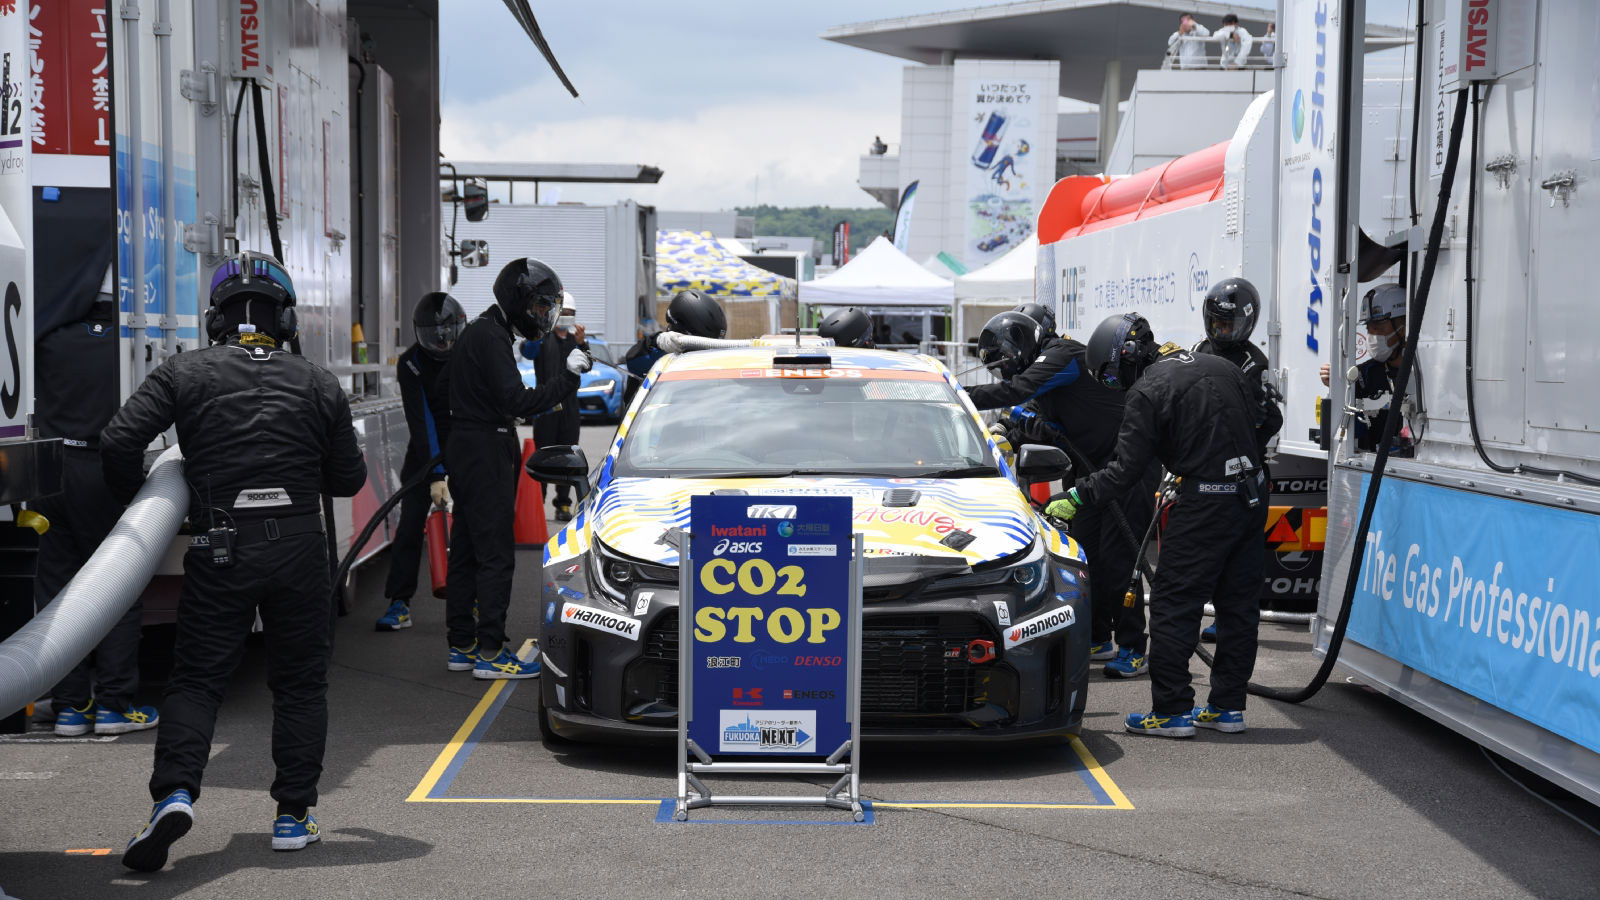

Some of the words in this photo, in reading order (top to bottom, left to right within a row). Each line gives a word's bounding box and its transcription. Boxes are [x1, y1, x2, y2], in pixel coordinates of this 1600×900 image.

[1306, 167, 1323, 355] Hydro
[765, 369, 862, 377] ENEOS
[1200, 483, 1237, 492] sparco
[247, 492, 280, 501] sparco
[711, 525, 767, 537] Iwatani
[729, 542, 763, 553] asics
[700, 558, 807, 597] CO2
[1364, 531, 1396, 601] The
[1402, 543, 1442, 618] Gas
[694, 607, 841, 643] STOP
[707, 656, 741, 668] 浪江町
[760, 655, 788, 664] NEDO
[794, 656, 842, 666] DENSO
[793, 690, 835, 699] ENEOS
[724, 732, 760, 741] FUKUOKA
[761, 729, 795, 745] NEXT
